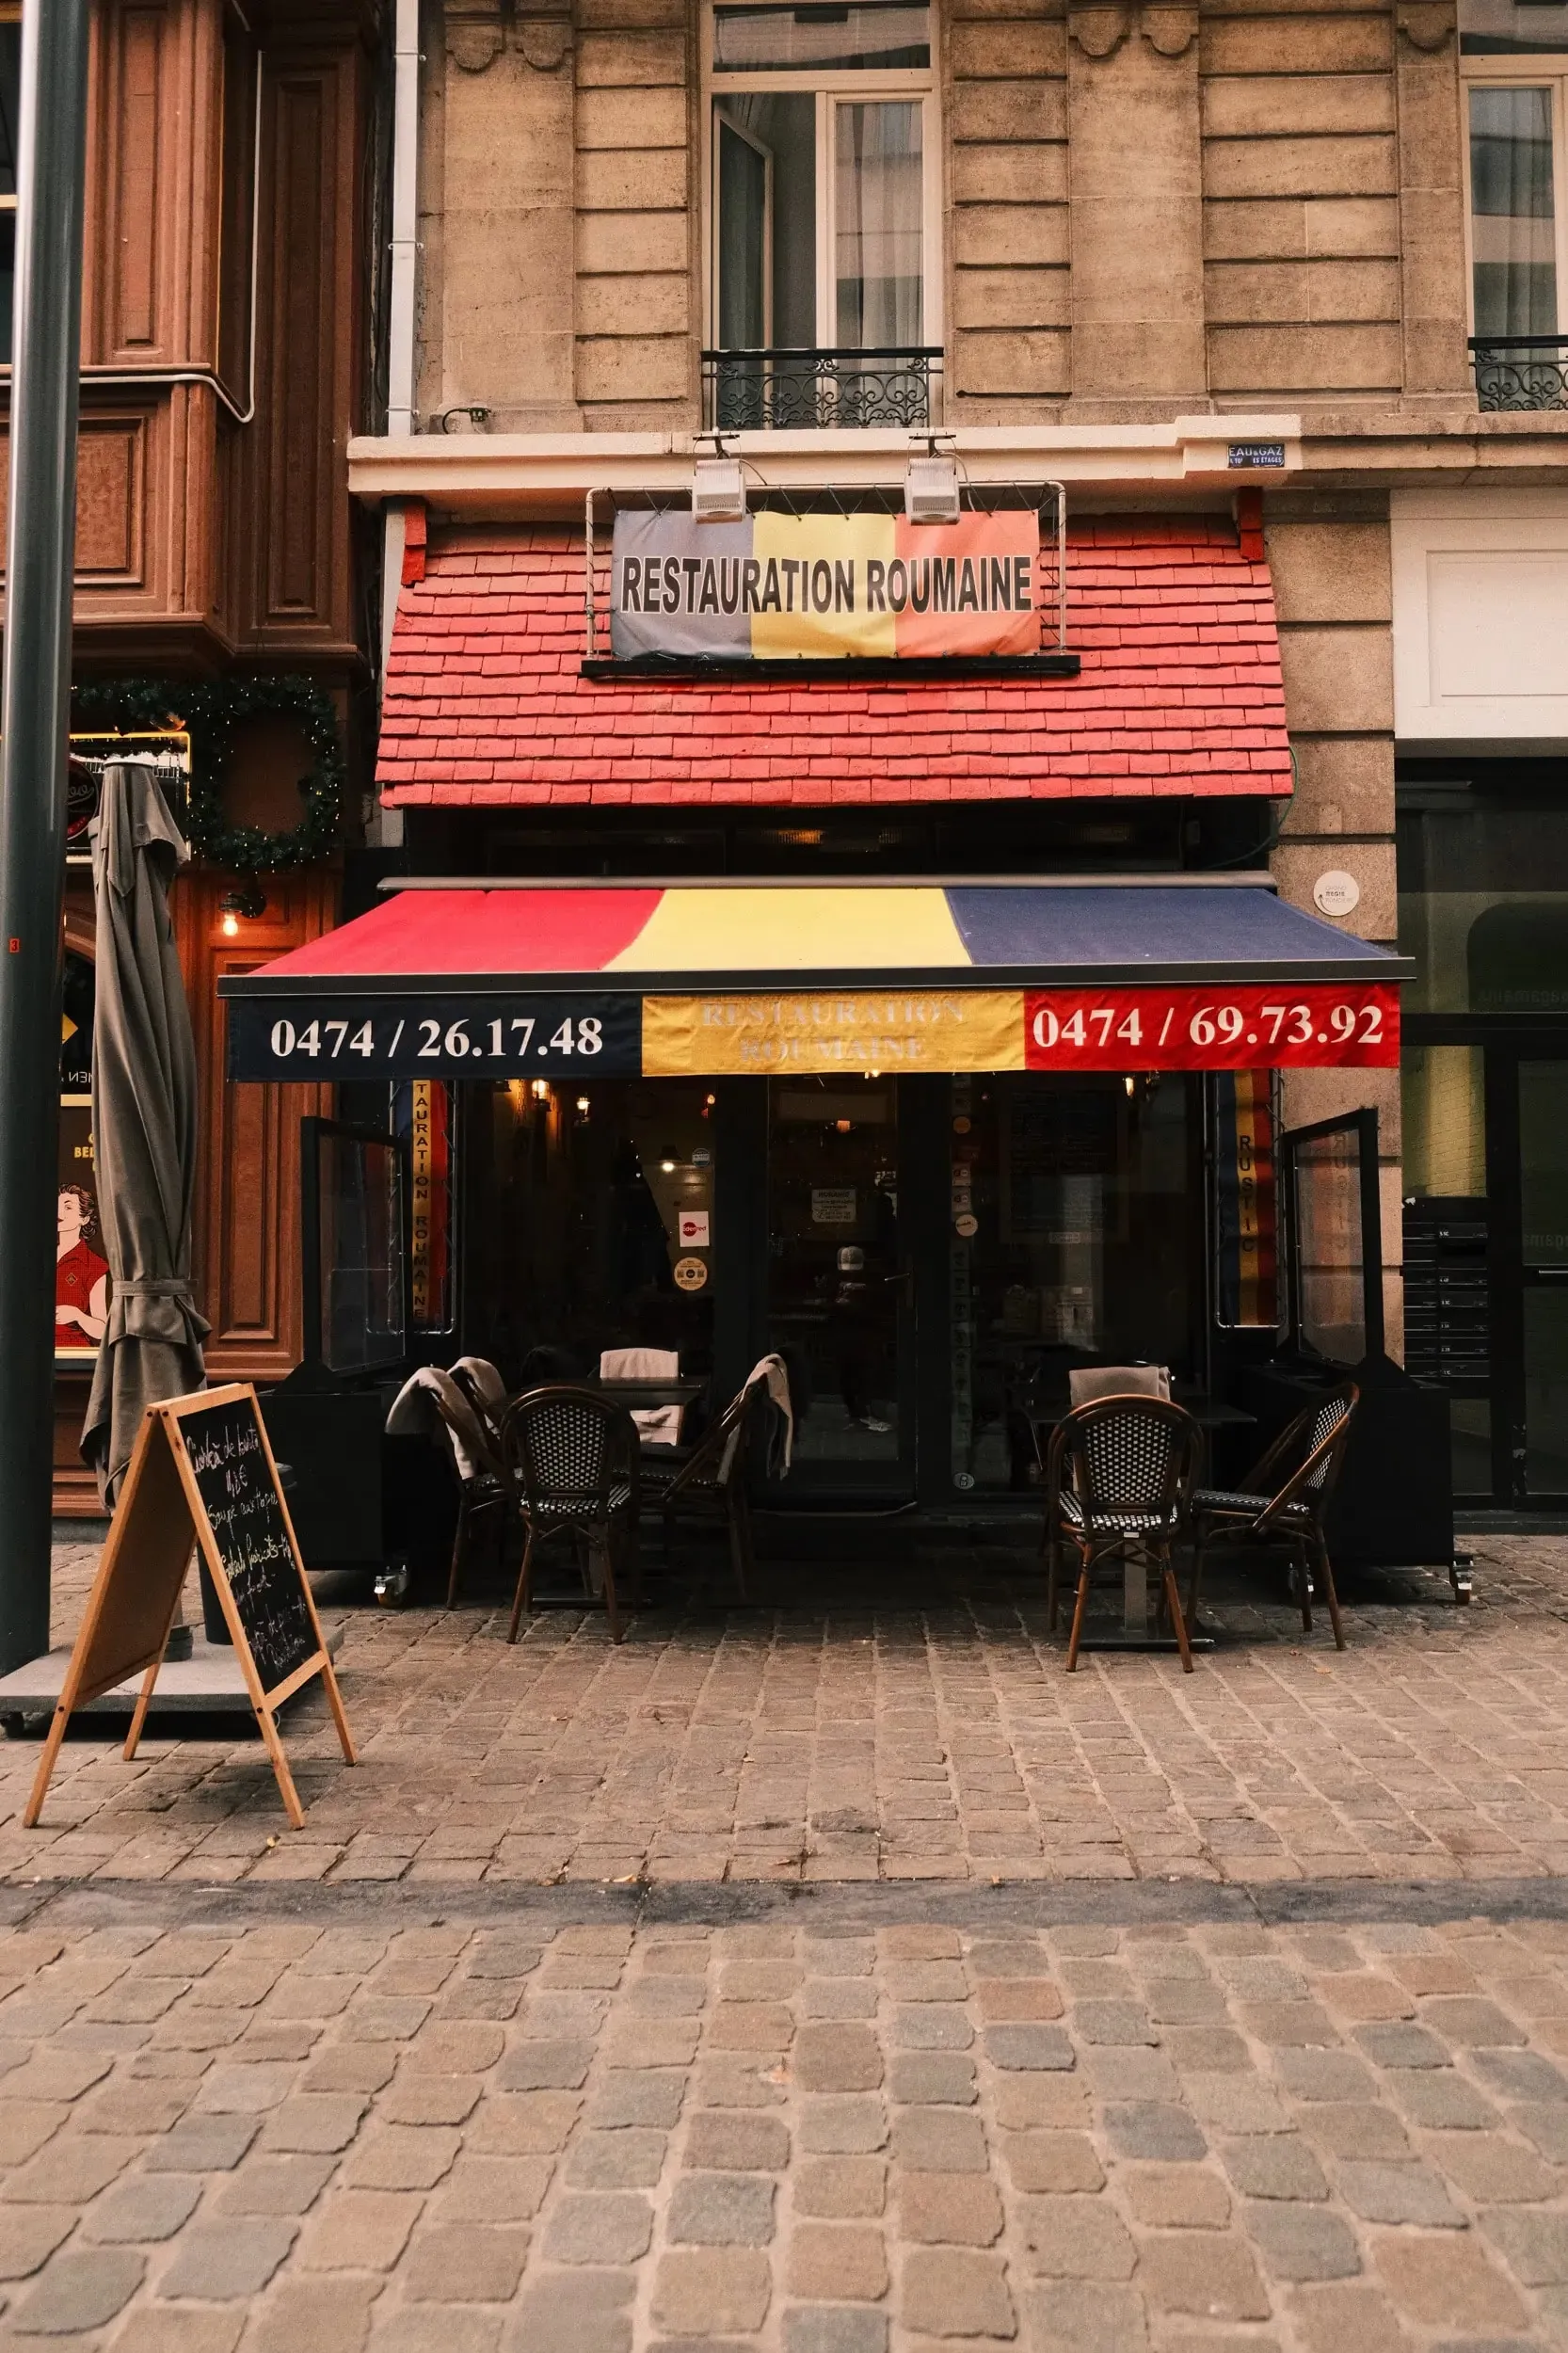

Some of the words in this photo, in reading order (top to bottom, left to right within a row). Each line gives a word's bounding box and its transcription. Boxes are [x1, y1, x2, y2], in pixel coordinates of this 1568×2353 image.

[1229, 447, 1253, 456] EAU
[1258, 446, 1283, 456] GAZ
[621, 556, 856, 616] RESTAURATION
[867, 554, 1033, 615] ROUMAINE
[11, 939, 18, 952] 3
[699, 1000, 964, 1027] RESTAURATION
[1032, 1008, 1144, 1048] 0474
[1158, 1007, 1175, 1047] /
[1190, 1004, 1384, 1046] 69.73.92
[270, 1019, 375, 1058] 0474
[388, 1019, 406, 1058] /
[417, 1017, 603, 1058] 26.17.48
[739, 1035, 927, 1062] ROUMAINE
[415, 1083, 429, 1199] TAURATION
[1239, 1135, 1255, 1253] RUSTIC
[413, 1215, 428, 1319] ROUMAINE
